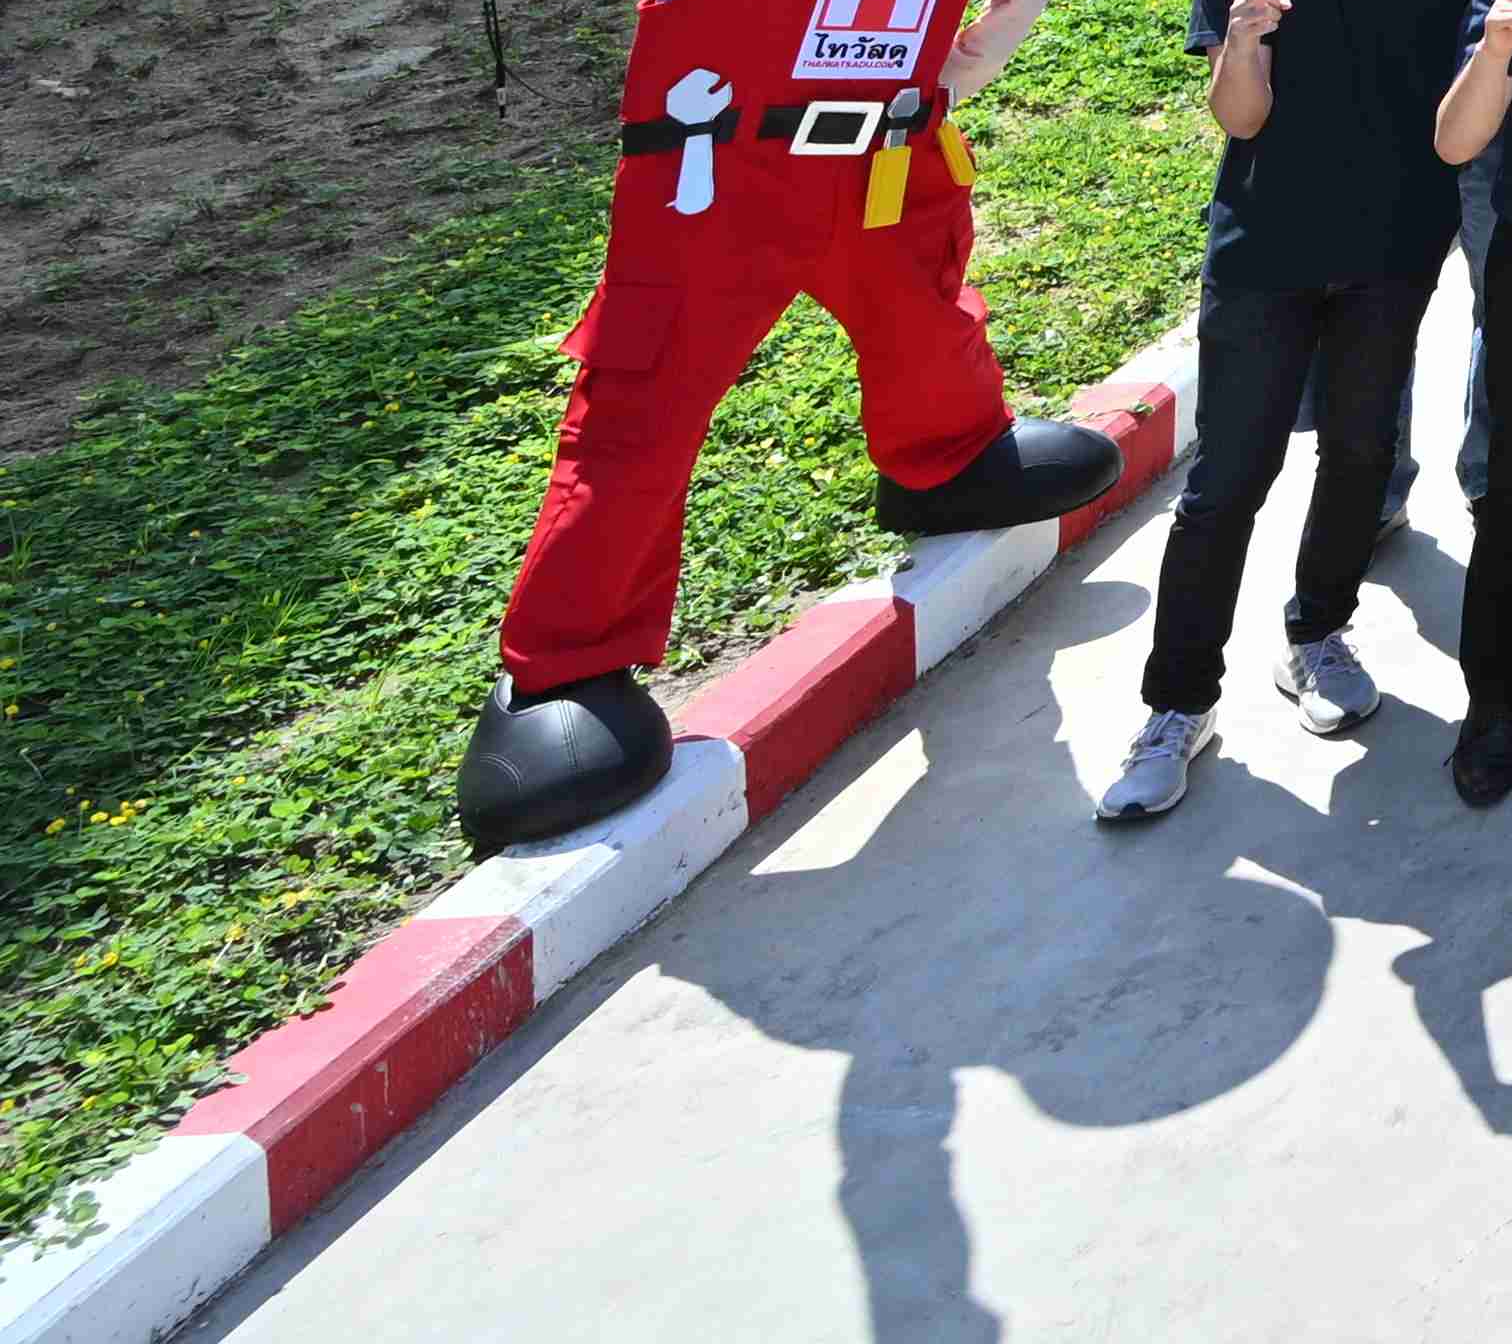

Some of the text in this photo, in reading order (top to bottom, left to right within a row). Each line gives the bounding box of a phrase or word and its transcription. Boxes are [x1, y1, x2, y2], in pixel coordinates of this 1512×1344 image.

[813, 32, 908, 69] ไทวัสดุ
[802, 59, 895, 69] THAIWATSADU.COM
